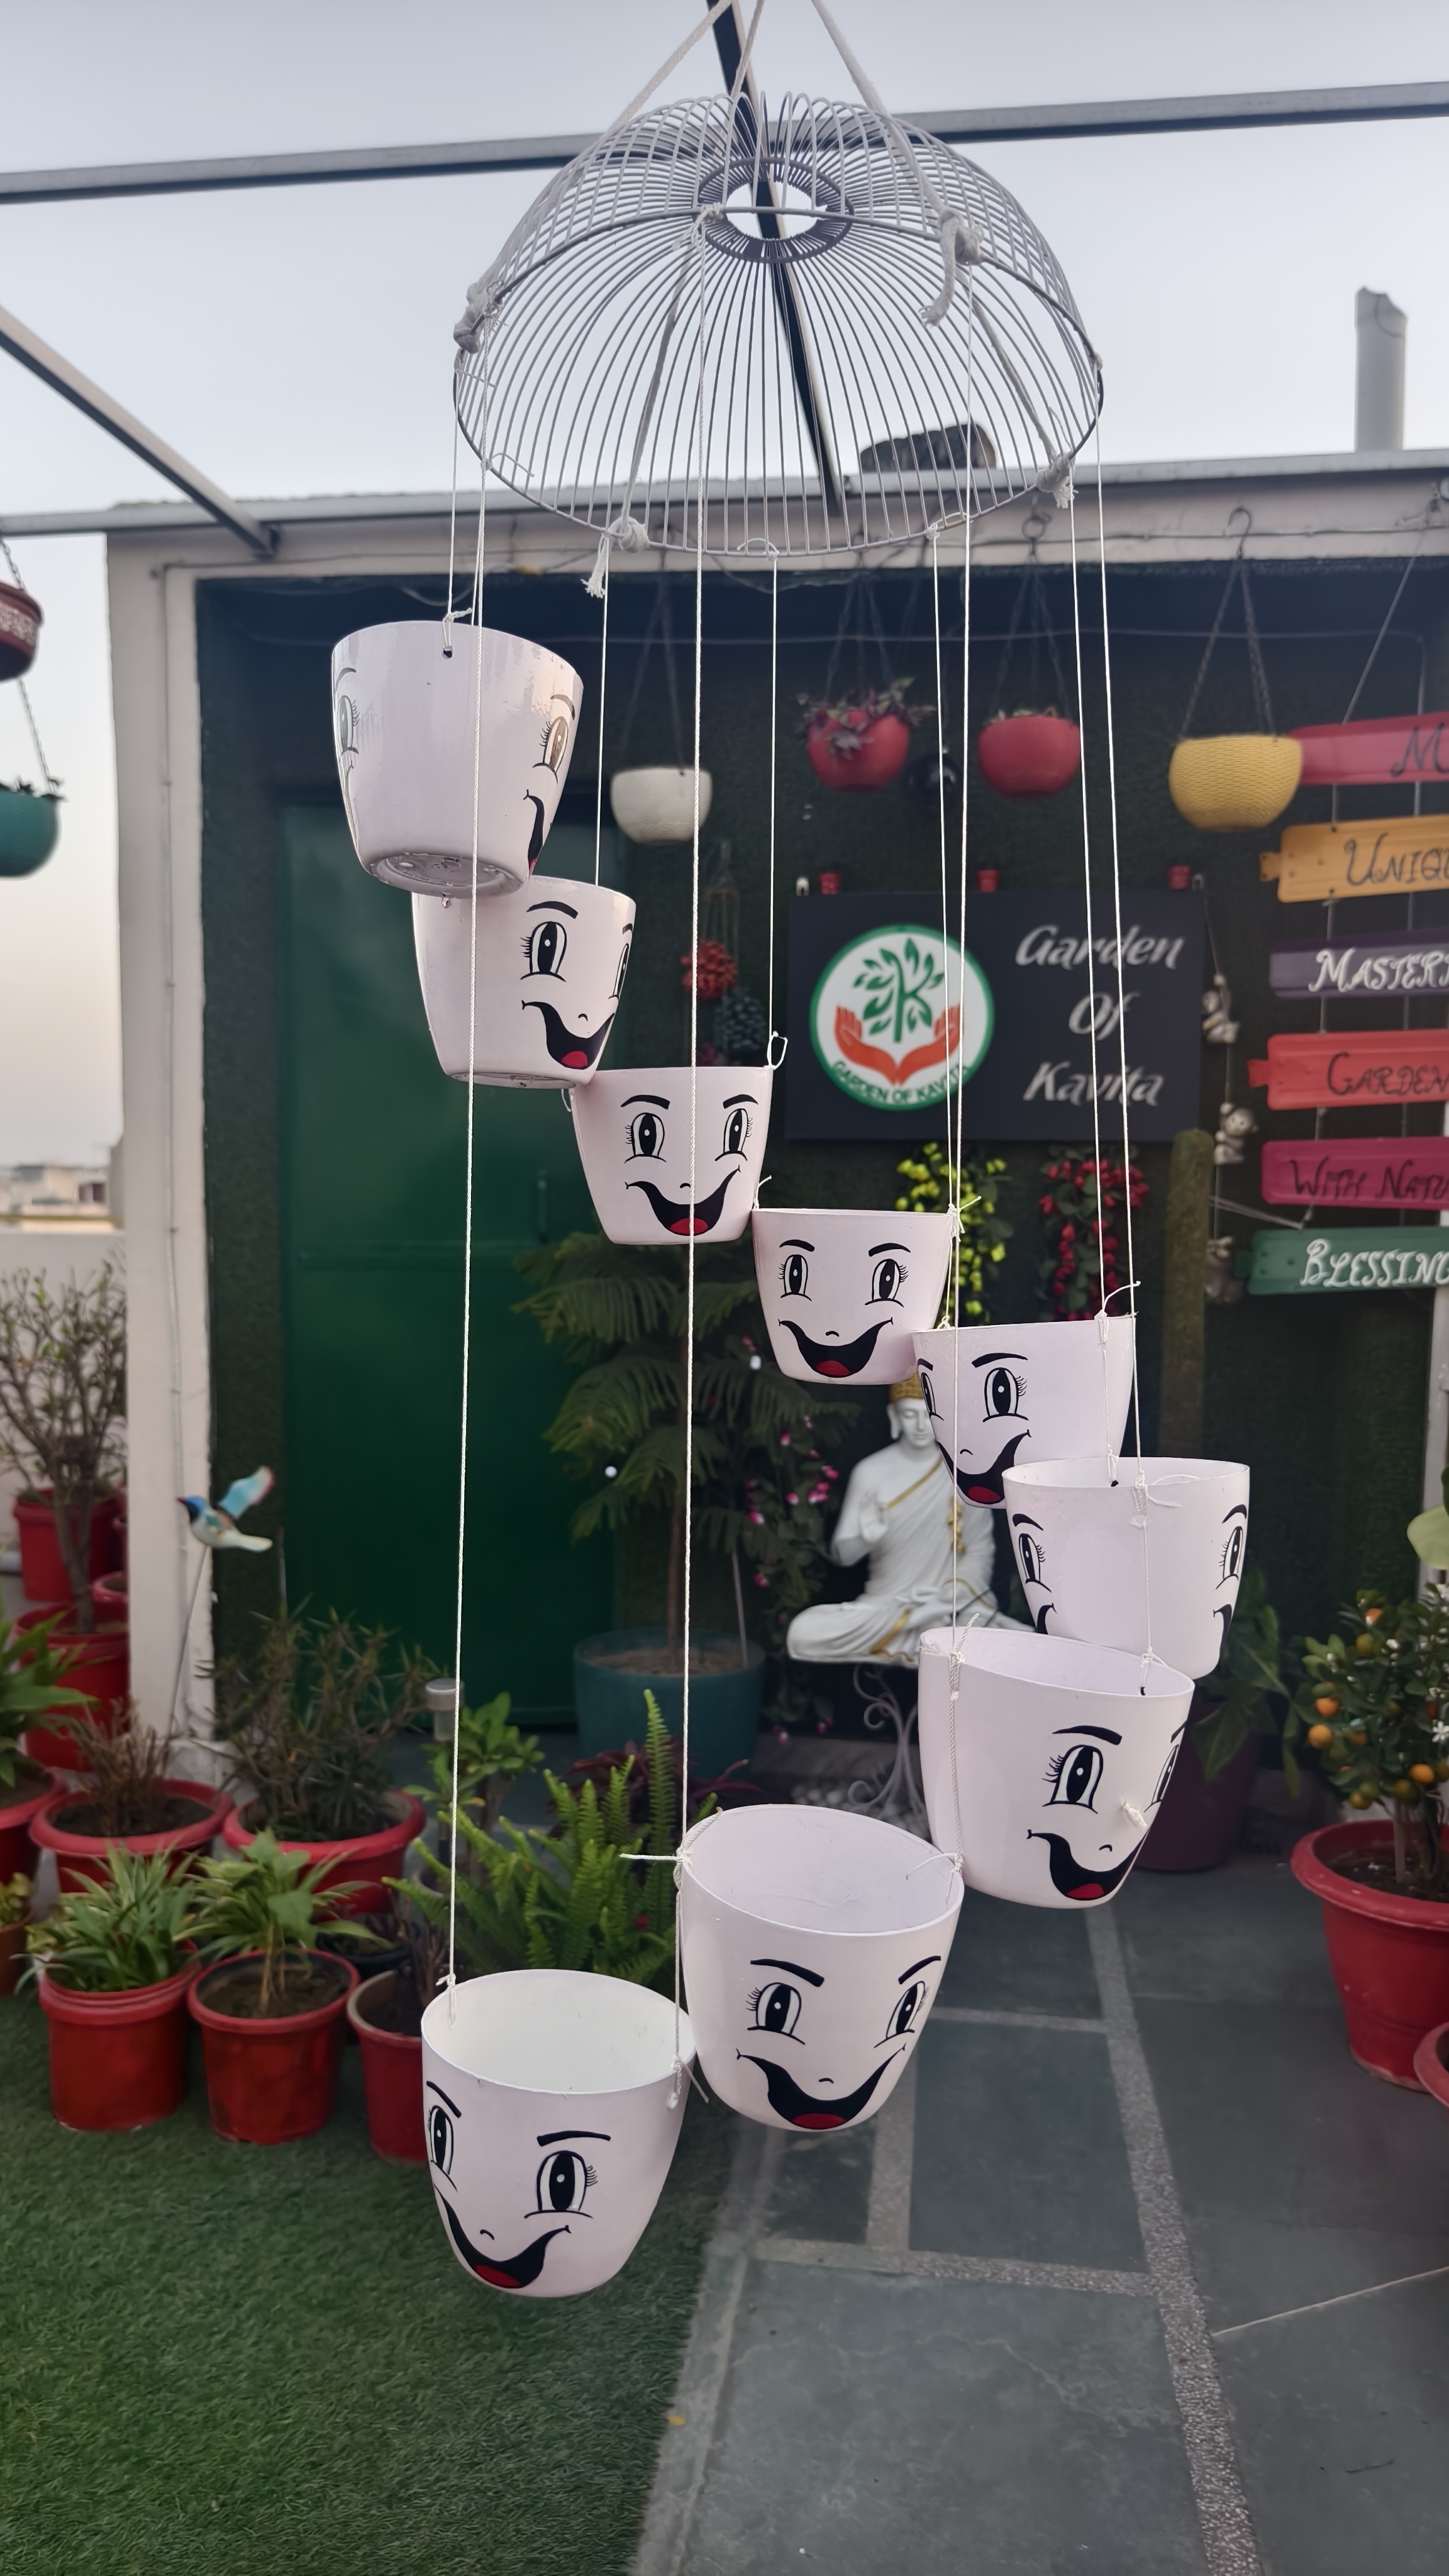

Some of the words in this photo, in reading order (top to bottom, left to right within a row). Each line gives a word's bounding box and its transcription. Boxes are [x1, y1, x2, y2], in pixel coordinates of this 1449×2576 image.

[1014, 924, 1184, 970] Garden
[1069, 991, 1140, 1040] Of
[1023, 1061, 1163, 1106] Kavita
